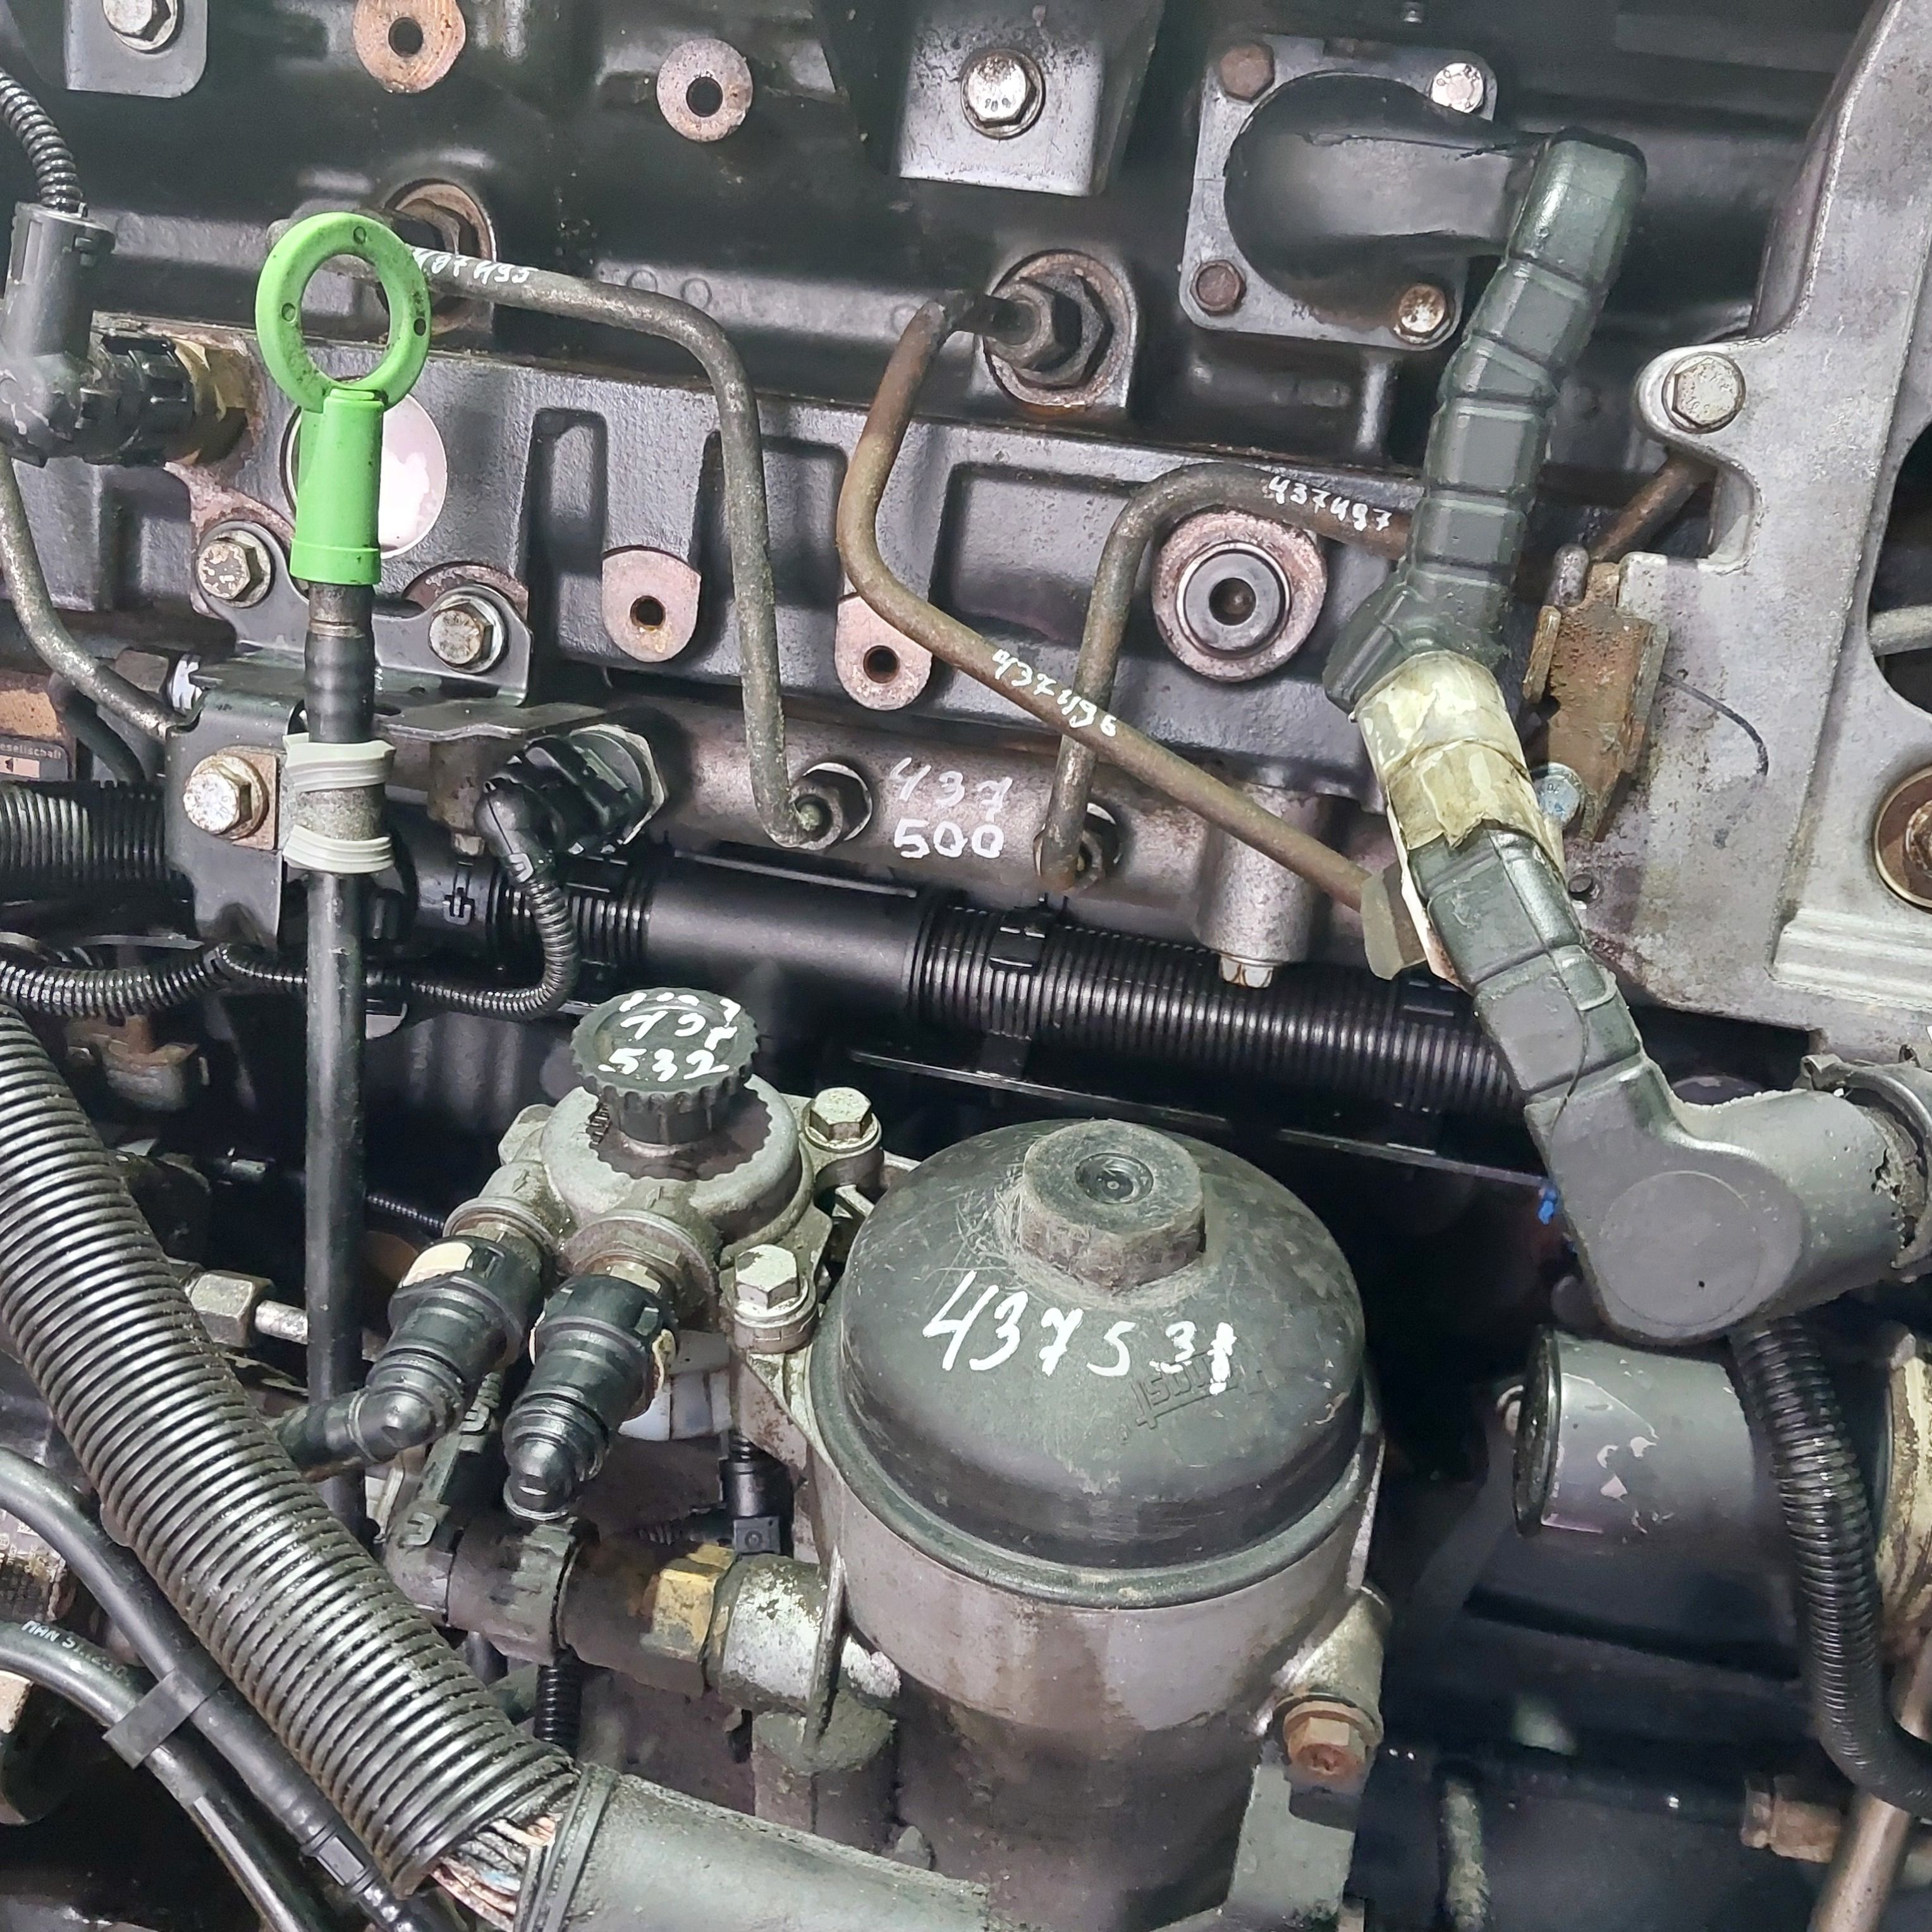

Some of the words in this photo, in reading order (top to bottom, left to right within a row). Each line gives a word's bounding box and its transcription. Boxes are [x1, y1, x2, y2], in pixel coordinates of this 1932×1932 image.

[890, 757, 1013, 822] 437
[894, 819, 1004, 859] 500
[597, 1048, 730, 1082] 532
[922, 1270, 1237, 1395] 437531
[21, 1620, 60, 1642] MAN
